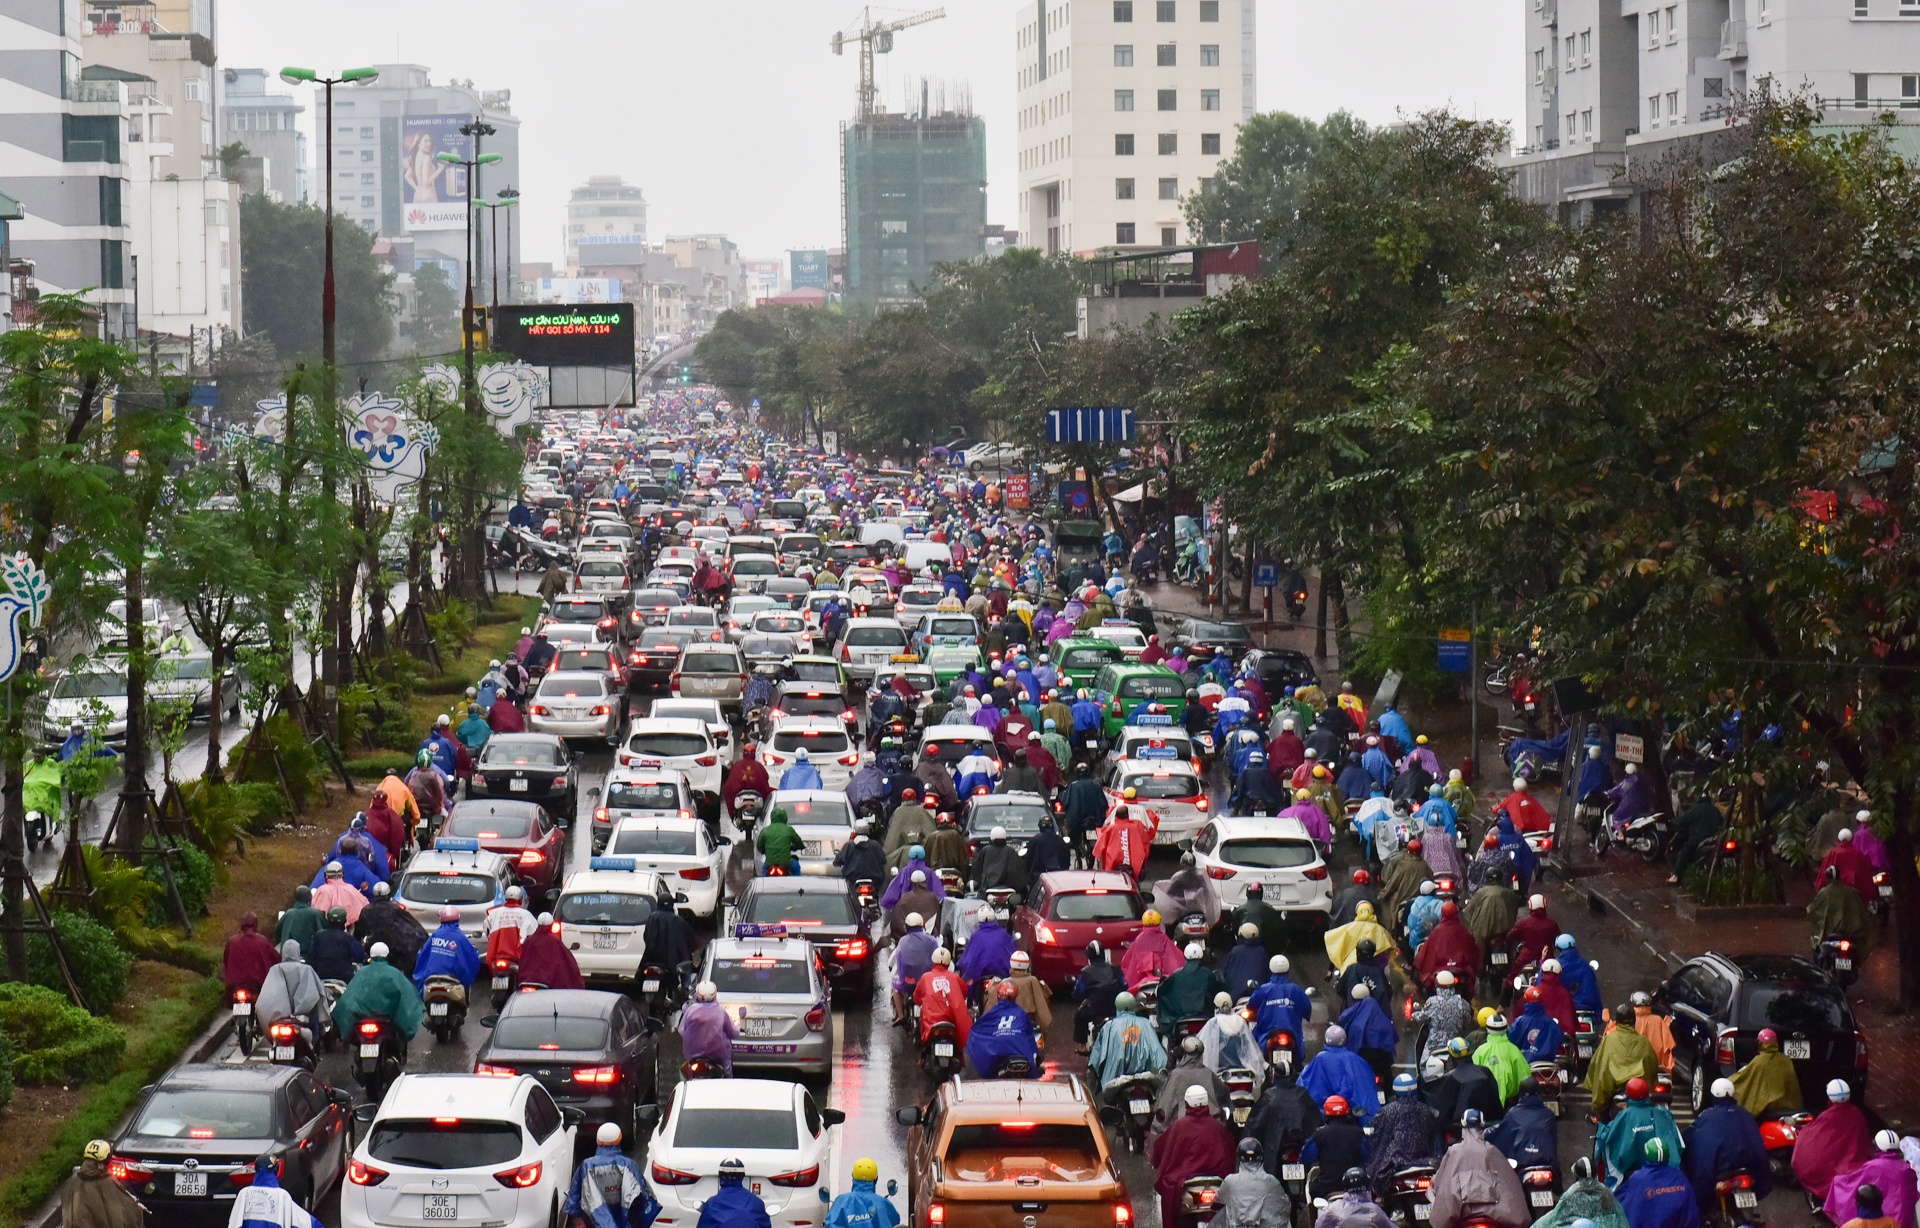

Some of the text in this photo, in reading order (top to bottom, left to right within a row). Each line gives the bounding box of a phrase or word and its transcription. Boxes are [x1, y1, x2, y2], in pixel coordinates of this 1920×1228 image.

[520, 317, 534, 325] KHI
[594, 325, 610, 334] 114
[431, 937, 449, 948] BIDV
[752, 1020, 766, 1028] 30A
[746, 1028, 771, 1037] 644.03
[1787, 1049, 1808, 1058] 9877
[183, 1173, 199, 1184] 30A
[176, 1184, 206, 1195] 286.59
[267, 1195, 276, 1215] LONG
[432, 1196, 450, 1207] 30E
[425, 1207, 456, 1218] 360.03
